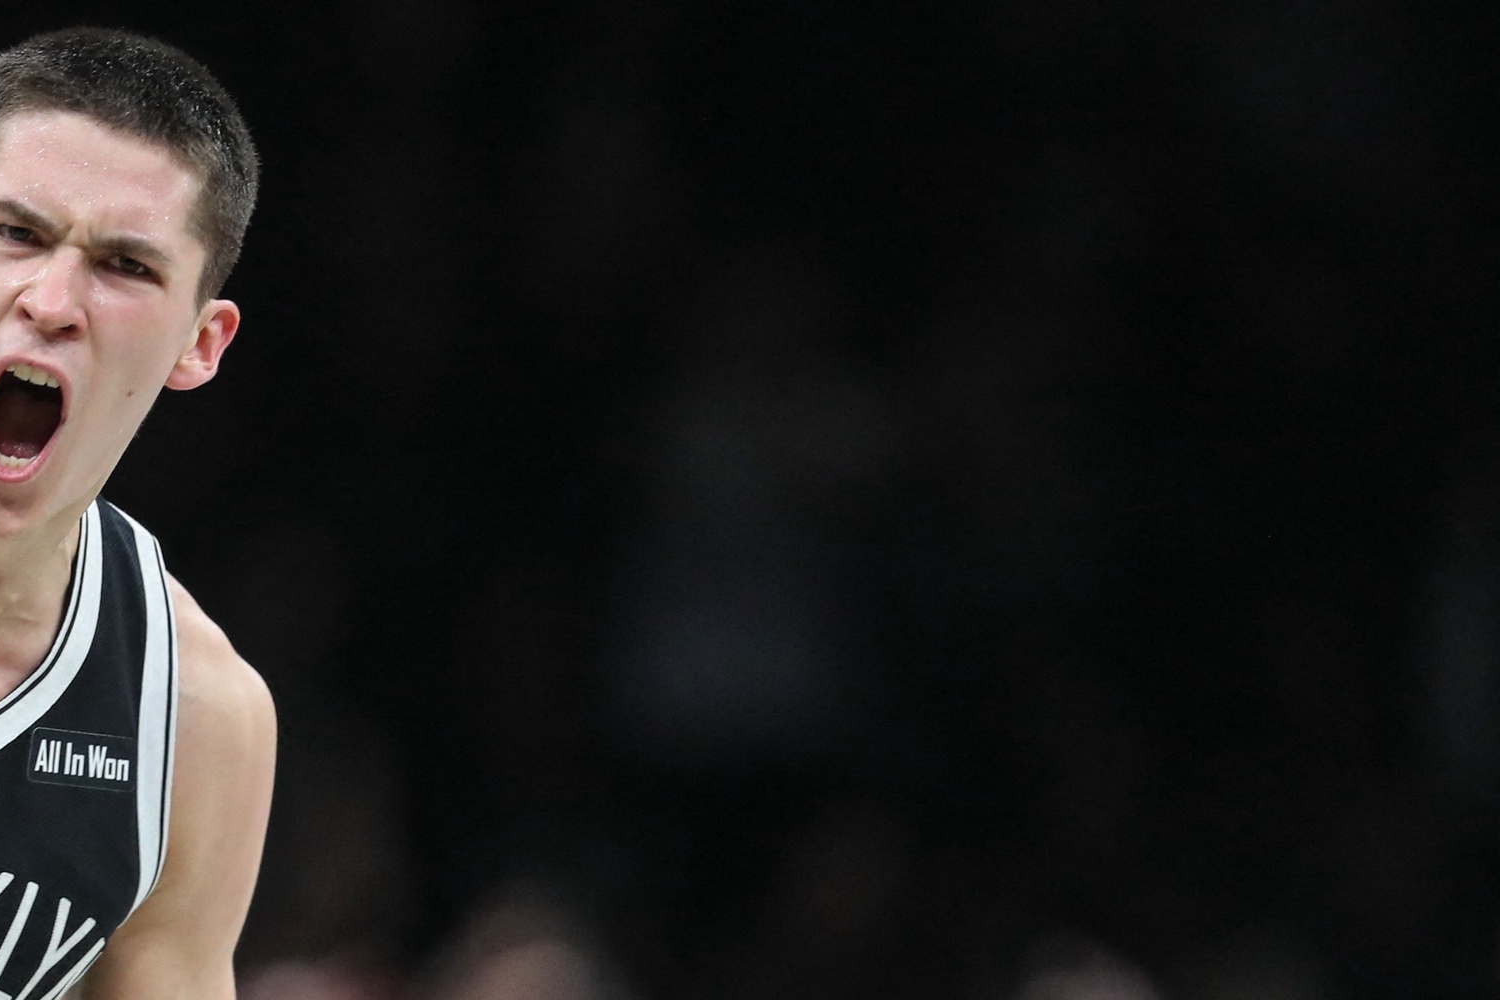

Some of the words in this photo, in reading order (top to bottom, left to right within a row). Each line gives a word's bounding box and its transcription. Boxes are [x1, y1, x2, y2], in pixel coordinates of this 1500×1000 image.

[34, 739, 62, 774] All
[63, 742, 85, 776] In
[88, 744, 130, 782] Won
